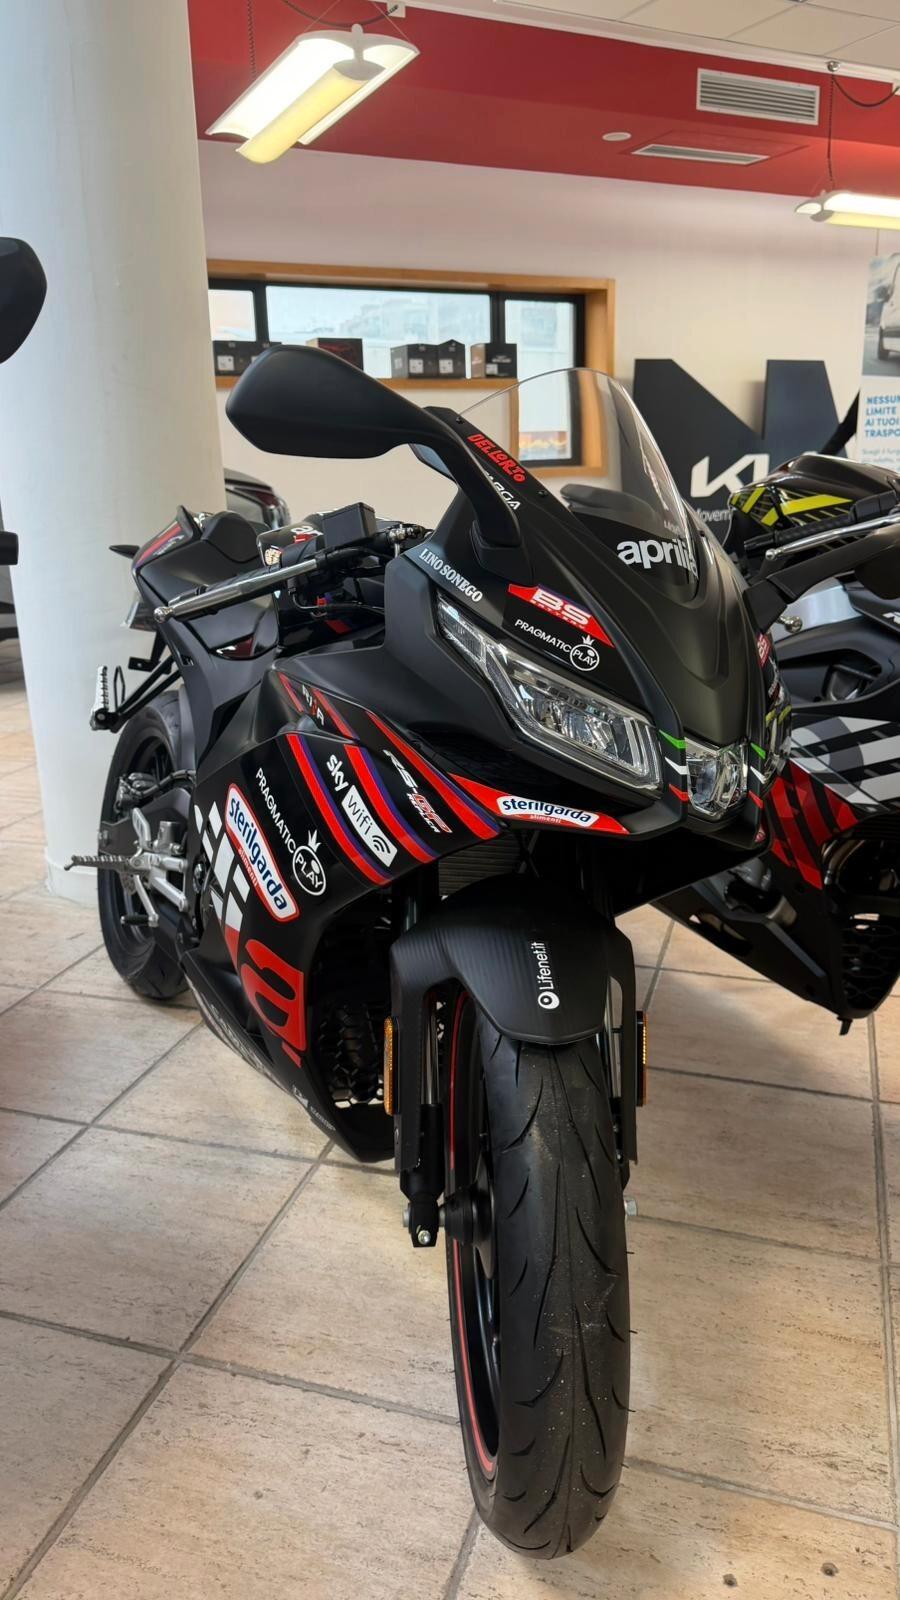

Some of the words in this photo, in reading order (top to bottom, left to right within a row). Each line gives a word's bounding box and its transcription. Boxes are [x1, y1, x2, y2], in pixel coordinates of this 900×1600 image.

[865, 406, 897, 416] LIMITE
[419, 548, 444, 575] LINO
[439, 560, 483, 603] SONEGO
[532, 588, 592, 626] BS
[514, 618, 572, 653] PRAGMATIC
[573, 649, 598, 667] PLAY
[326, 754, 349, 792] sky
[347, 794, 373, 836] wifi
[502, 798, 592, 823] sterilgarda
[255, 767, 297, 854] PRAGMATIC
[295, 854, 324, 889] PLAY
[228, 796, 288, 911] sterilgarda
[530, 941, 555, 990] Lifenet.it
